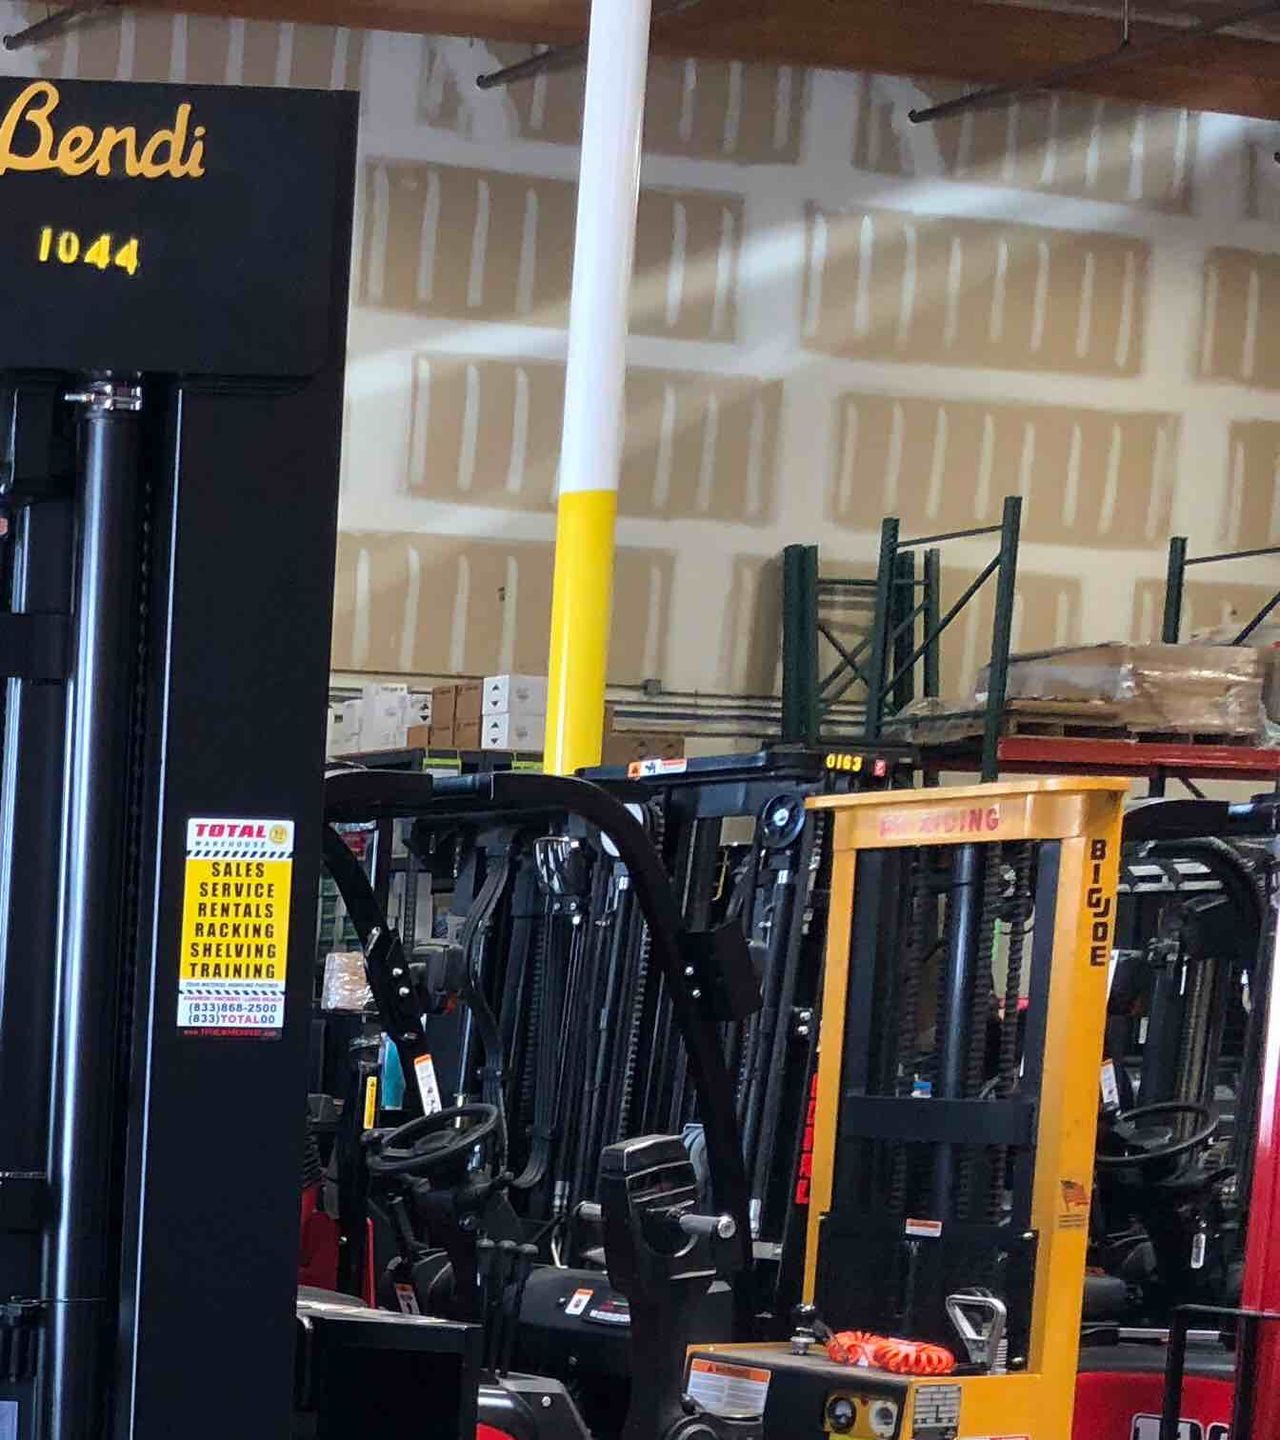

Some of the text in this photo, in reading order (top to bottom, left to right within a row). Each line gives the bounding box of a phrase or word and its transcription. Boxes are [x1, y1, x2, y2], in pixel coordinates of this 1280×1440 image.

[39, 227, 139, 275] 1044
[825, 753, 864, 772] 0163
[195, 823, 267, 838] TOTAL
[195, 840, 266, 849] WAREHOUSE
[211, 861, 265, 878] SALES
[199, 882, 275, 898] SERVICE
[197, 902, 274, 919] RENTALS
[1087, 839, 1111, 967] BIG JOE
[195, 922, 274, 939] RACKING
[190, 942, 277, 959] SHELVING
[190, 962, 276, 979] TRAINING
[188, 1002, 277, 1013] (833)868-2500
[188, 1013, 276, 1024] (833)TOTAL00
